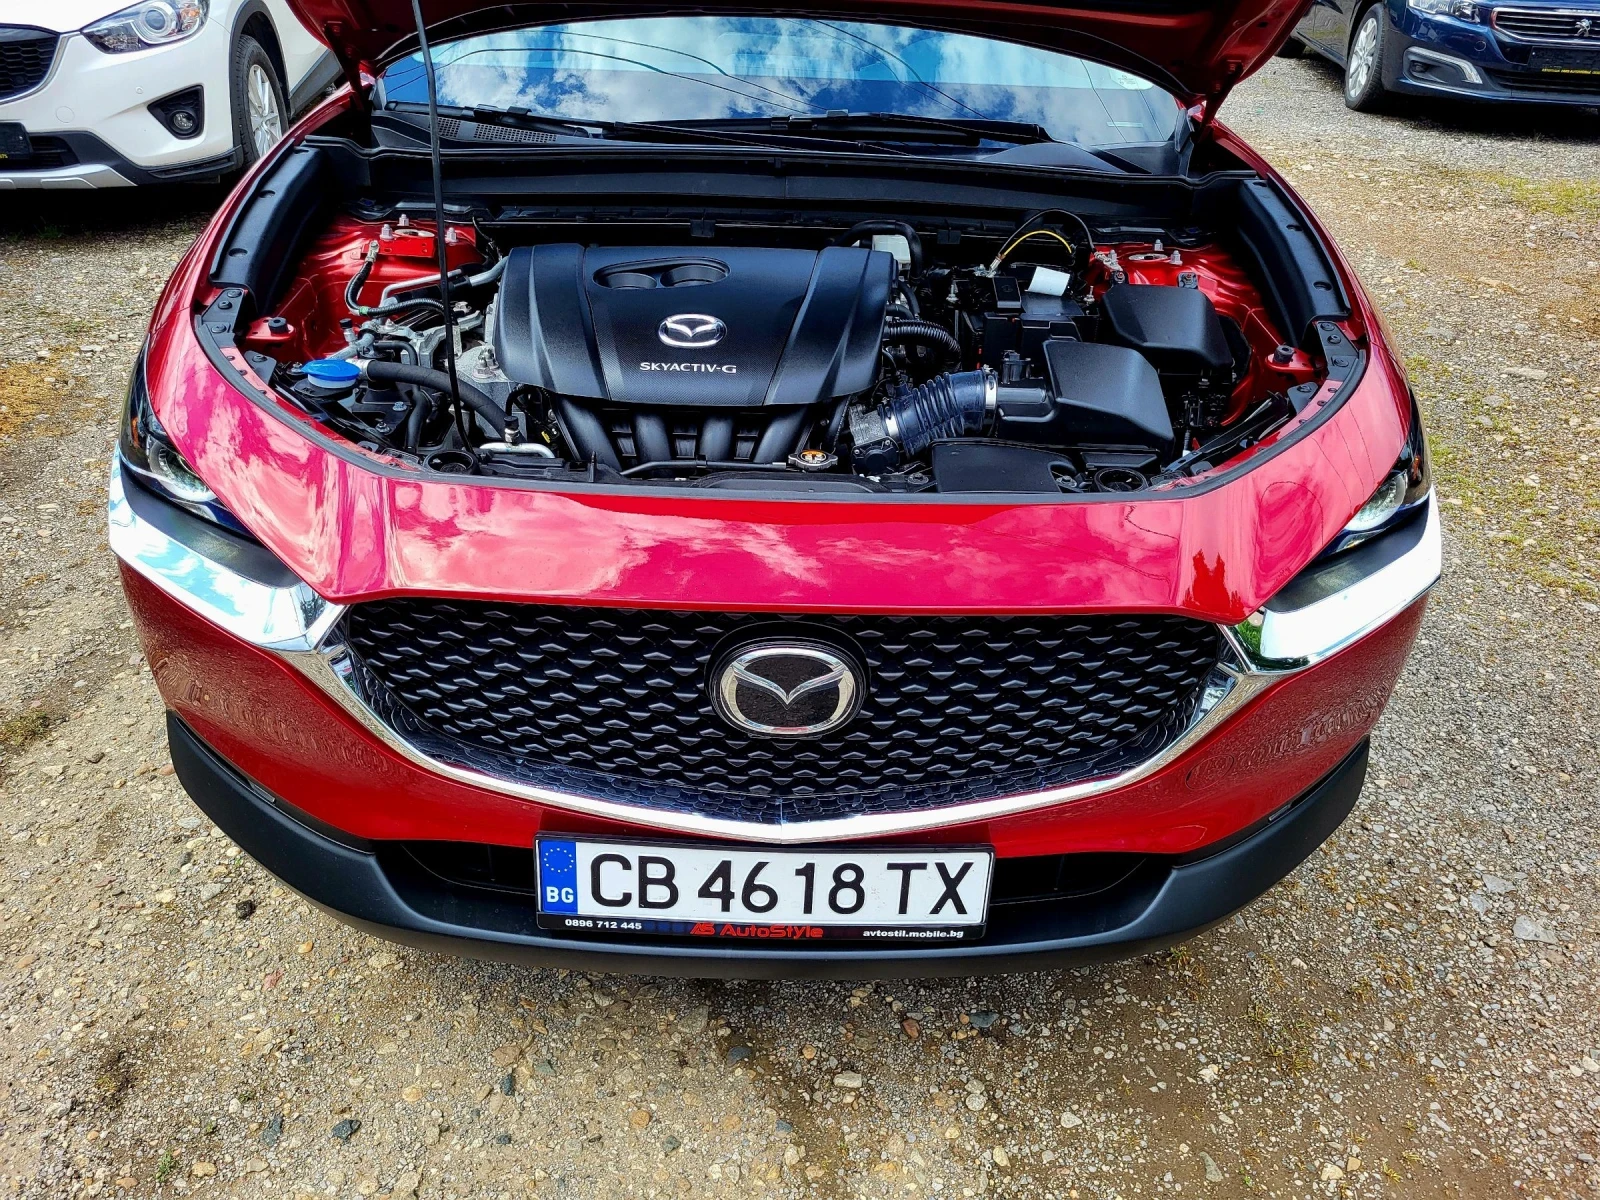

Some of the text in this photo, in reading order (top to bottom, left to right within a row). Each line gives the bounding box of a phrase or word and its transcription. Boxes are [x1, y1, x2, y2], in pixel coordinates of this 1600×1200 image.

[639, 361, 737, 374] SKYACTIV-G
[590, 853, 974, 914] CB 4618 TX
[546, 886, 574, 903] BG
[564, 918, 642, 930] 0896 712 445
[720, 923, 824, 940] AutoStyle
[862, 929, 964, 939] avtostil.mobile.bg
